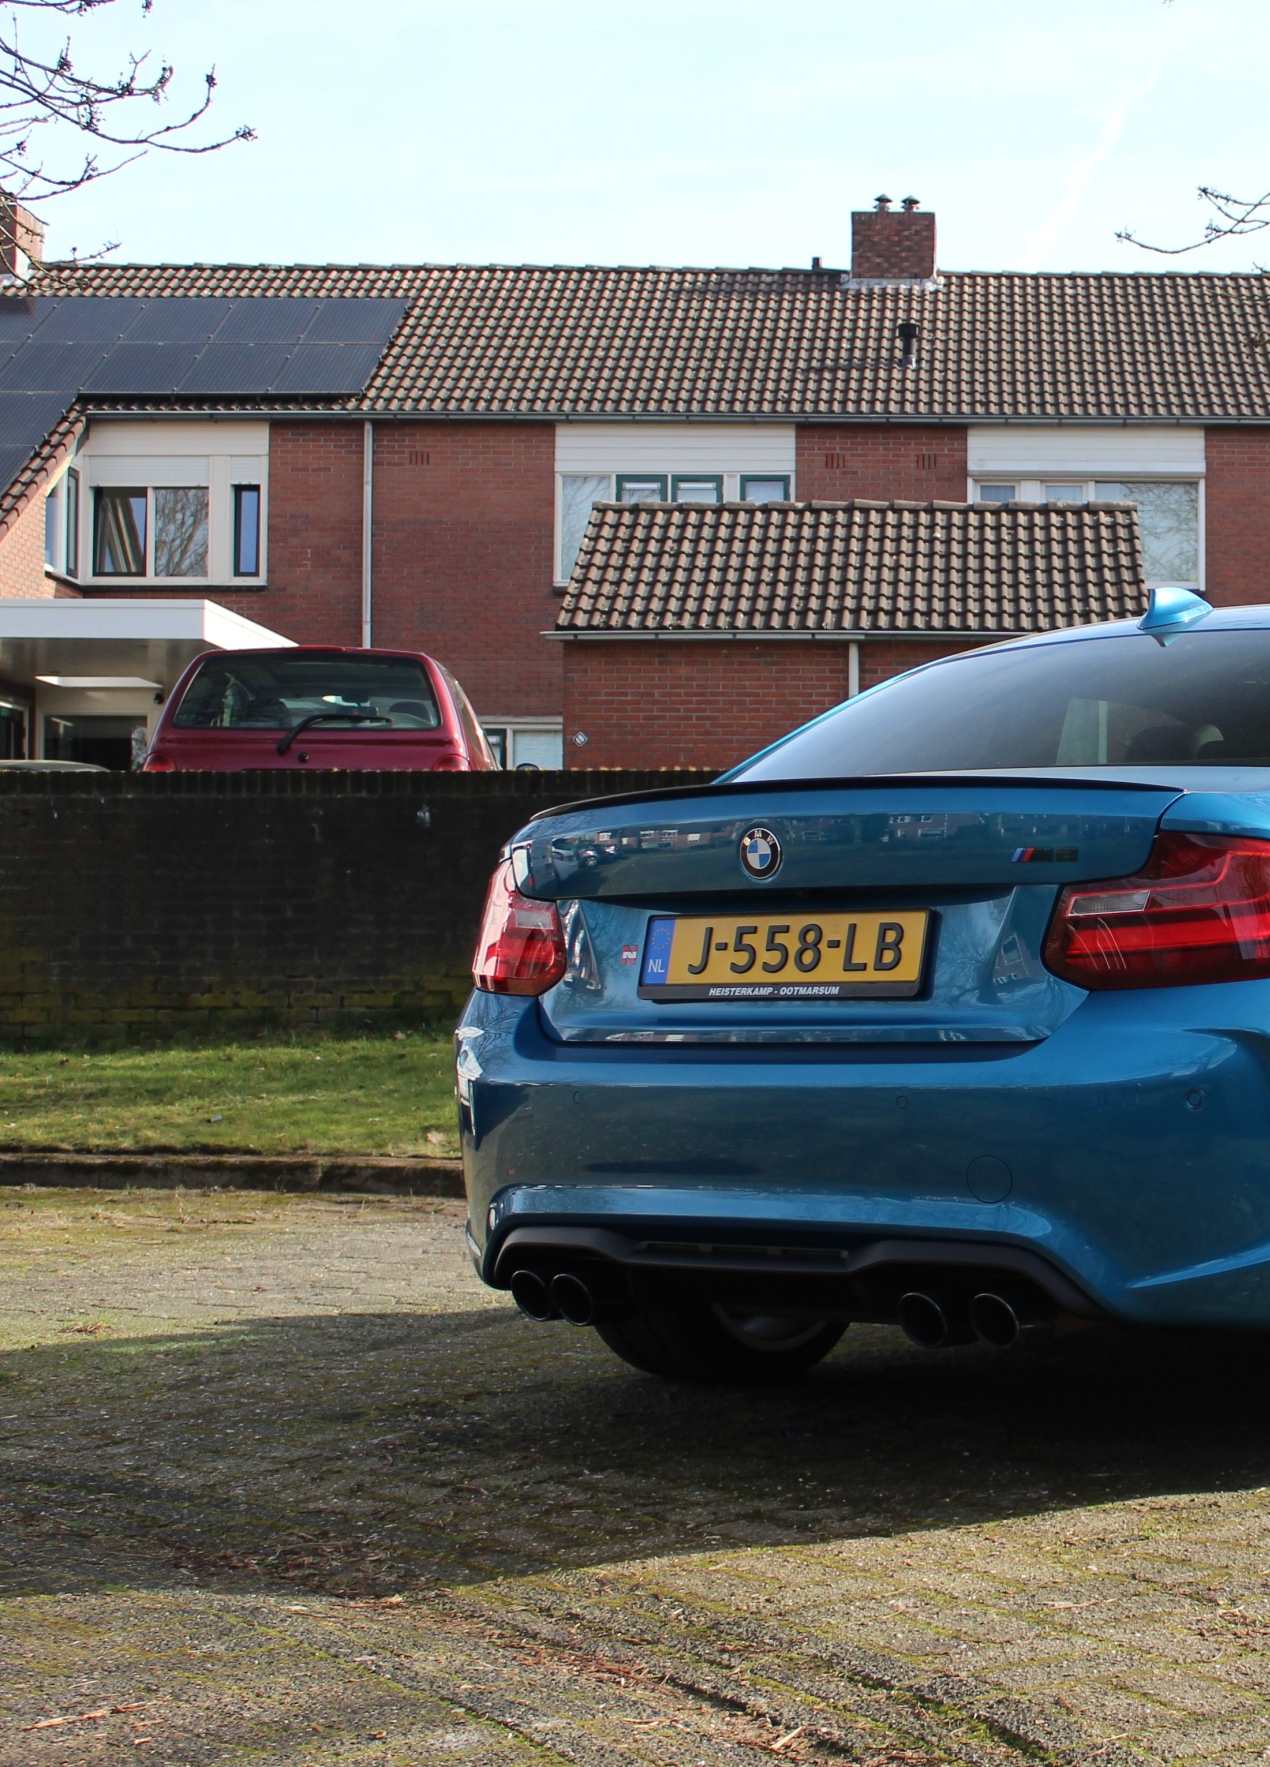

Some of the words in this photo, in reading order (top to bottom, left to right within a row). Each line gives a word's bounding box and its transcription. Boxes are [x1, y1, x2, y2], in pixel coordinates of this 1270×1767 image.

[742, 830, 776, 847] BMW
[687, 921, 905, 976] J-558-LB
[648, 958, 666, 973] NL
[709, 986, 774, 997] HEISTERKAMP
[780, 985, 840, 996] OOTMARSUM
